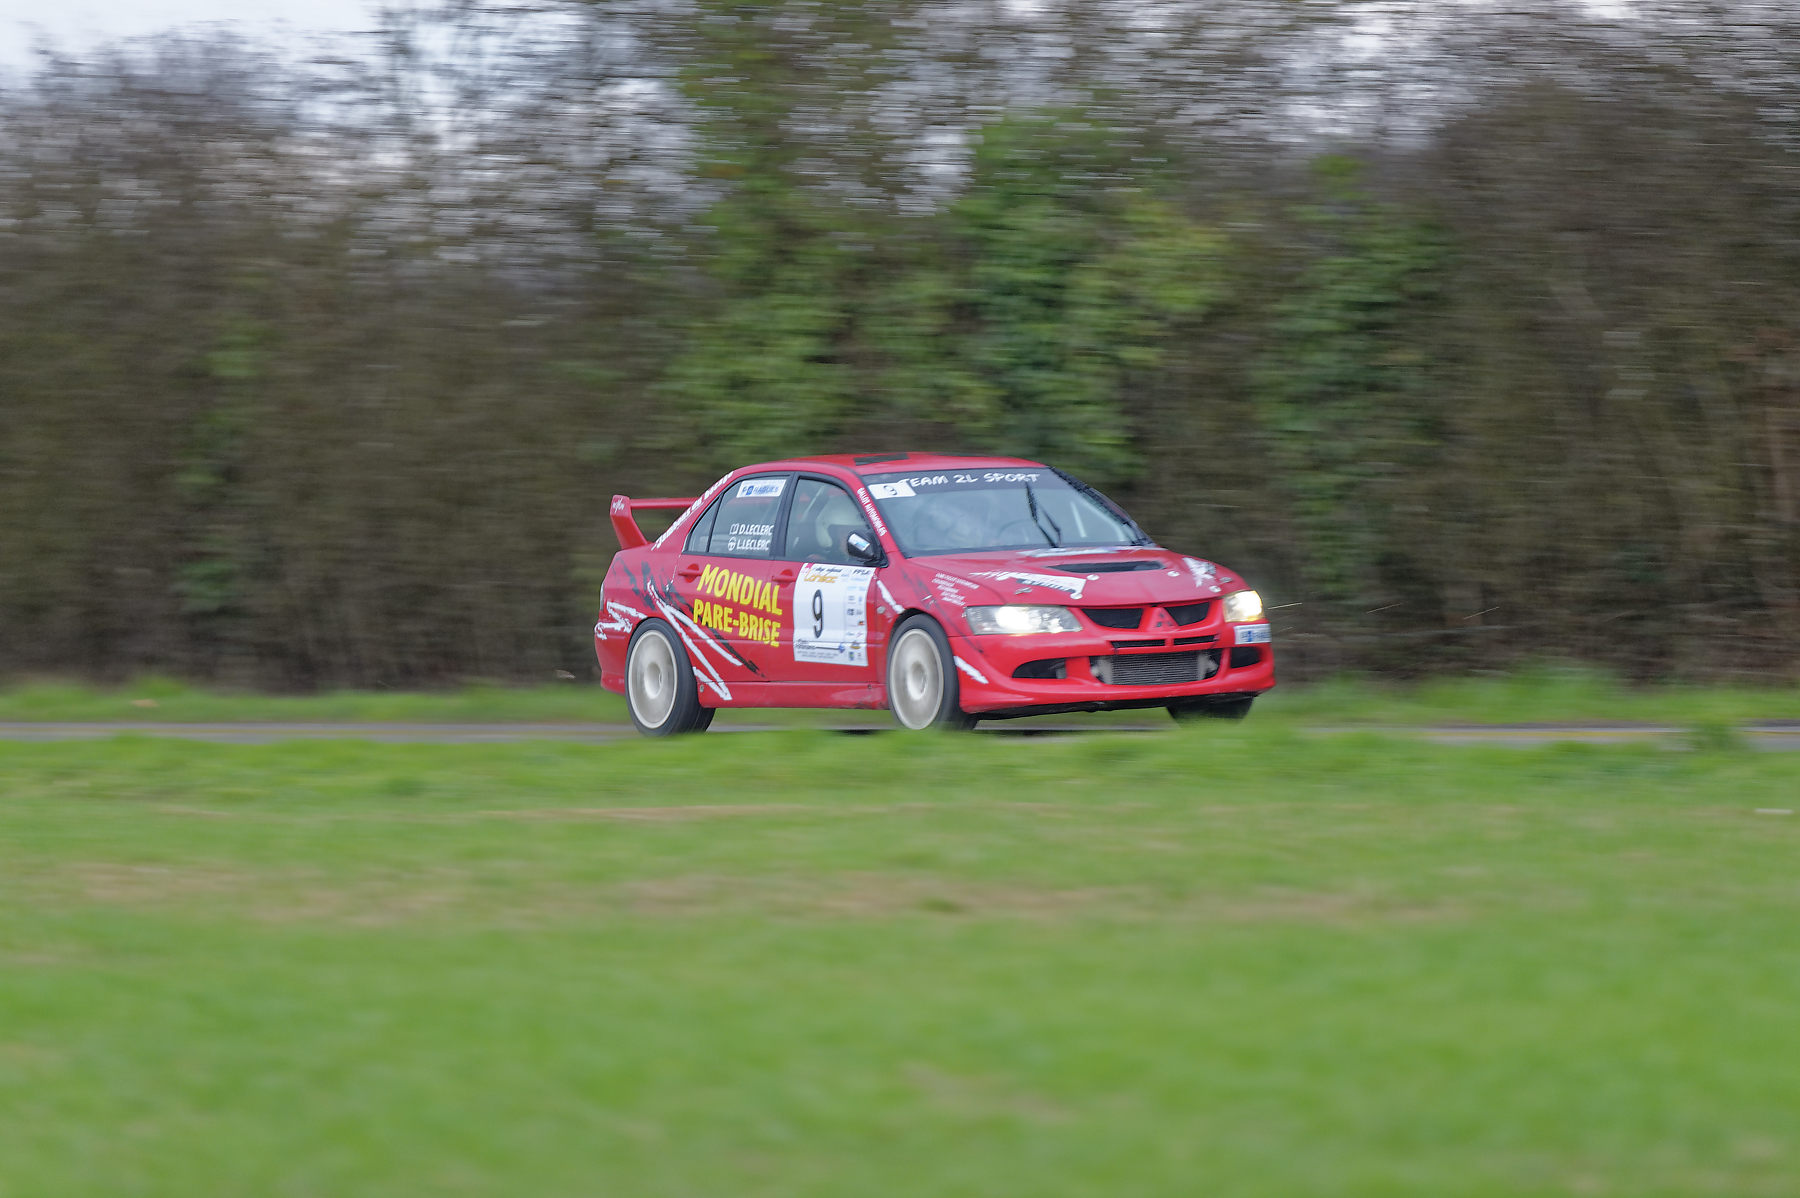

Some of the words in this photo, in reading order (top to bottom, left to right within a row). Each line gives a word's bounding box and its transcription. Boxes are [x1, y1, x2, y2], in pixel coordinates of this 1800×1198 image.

[898, 475, 949, 487] TEAM
[953, 474, 979, 484] 2L
[983, 472, 1041, 483] SPORT
[696, 563, 783, 616] MONDIAL
[812, 589, 824, 639] 9
[693, 598, 781, 648] PARE-BRISE
